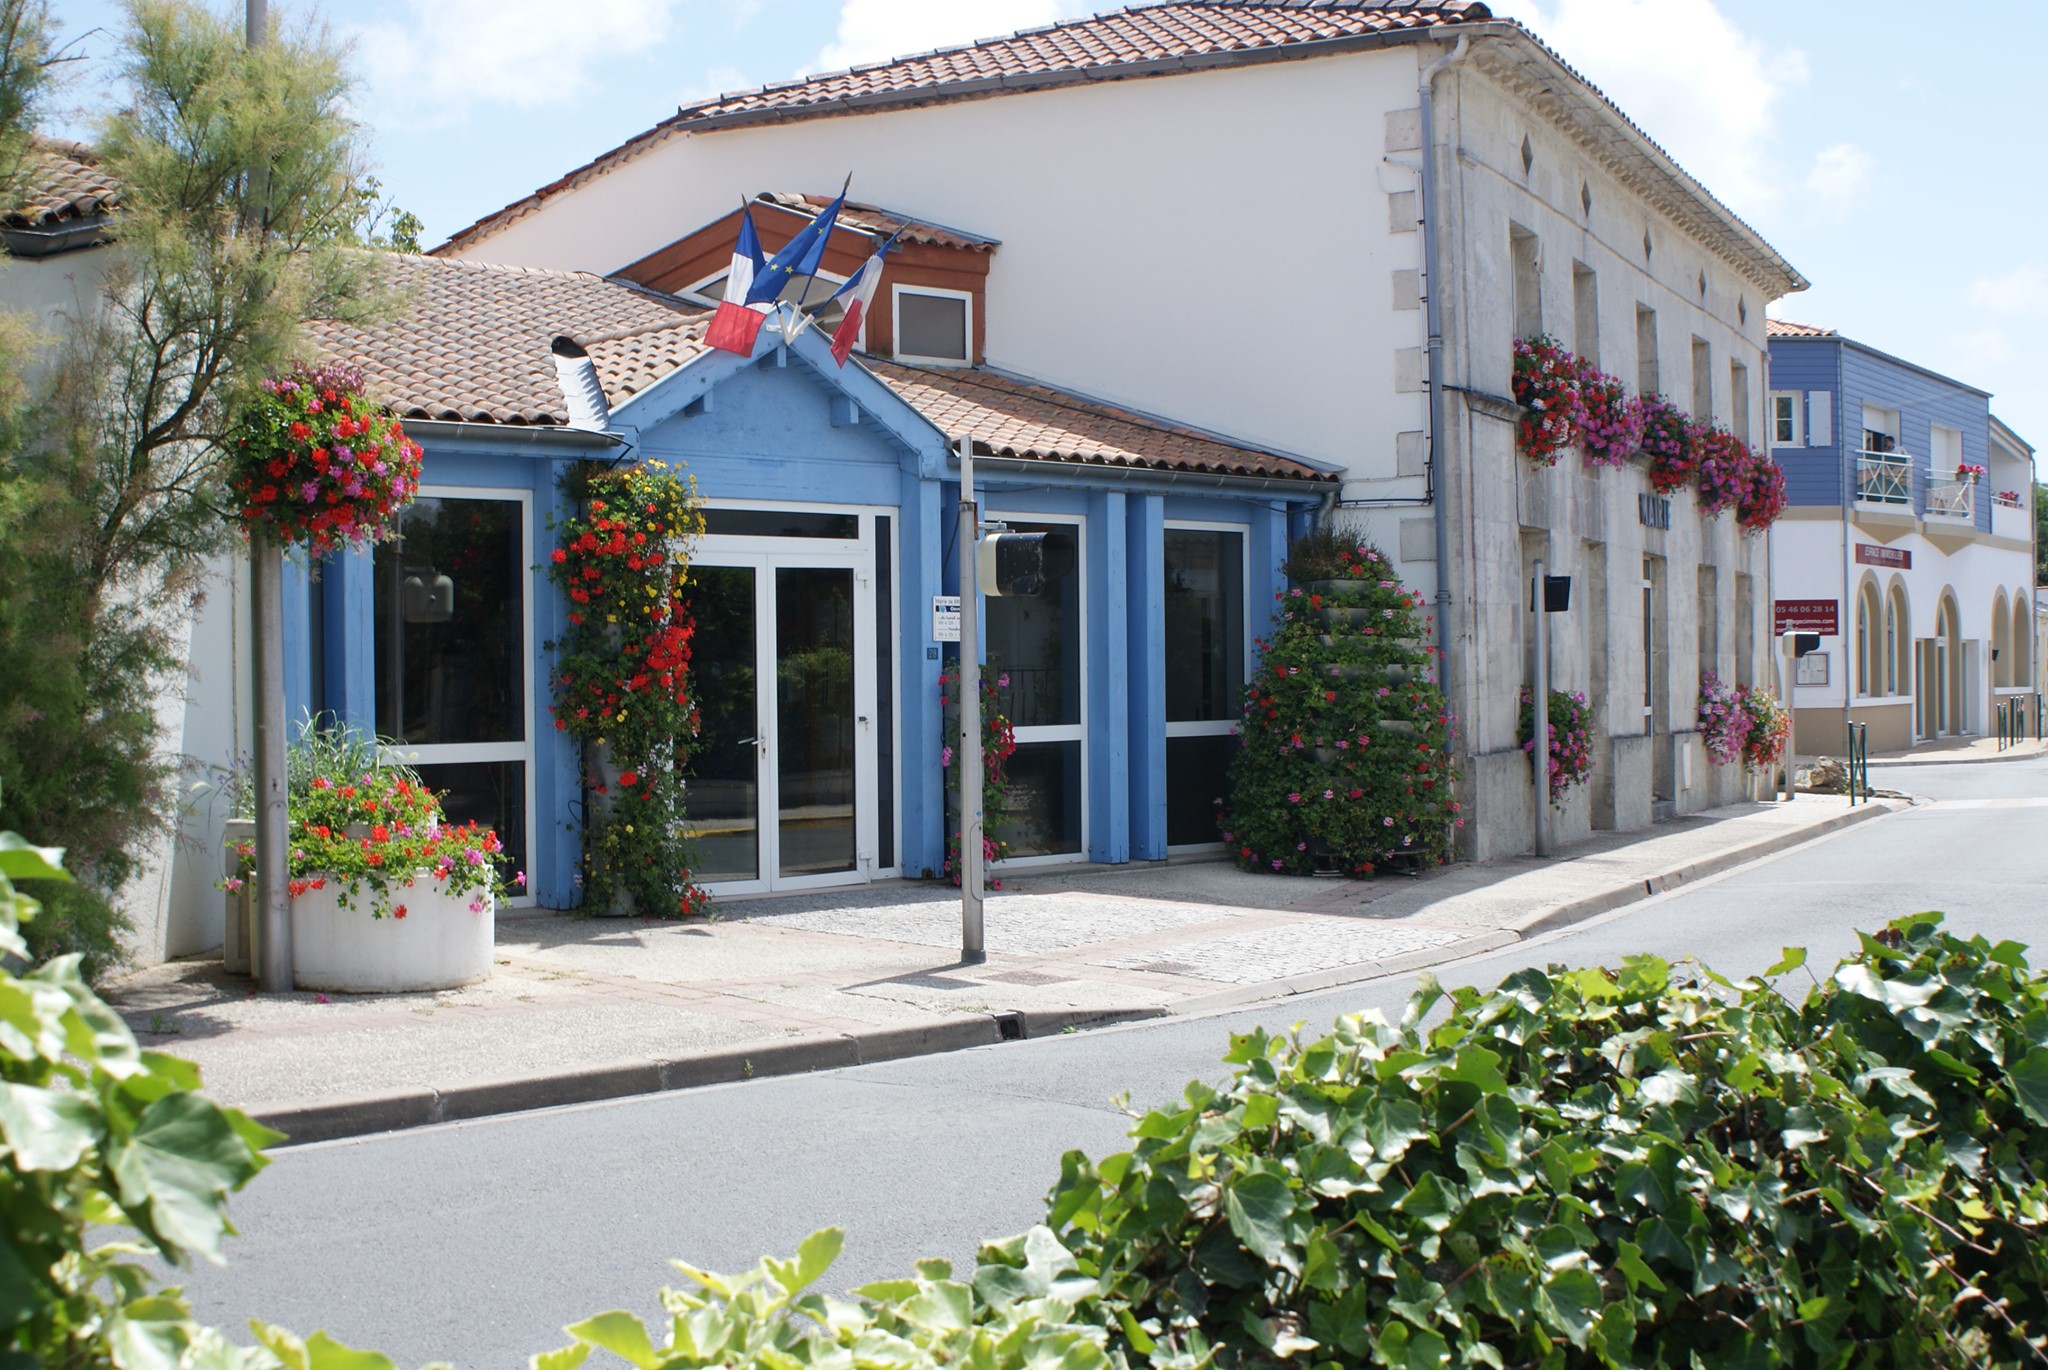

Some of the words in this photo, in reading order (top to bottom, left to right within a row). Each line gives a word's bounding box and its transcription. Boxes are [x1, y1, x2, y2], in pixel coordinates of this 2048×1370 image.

[1638, 493, 1669, 530] MAIRIE
[1812, 605, 1823, 613] 28
[928, 649, 937, 659] 28
